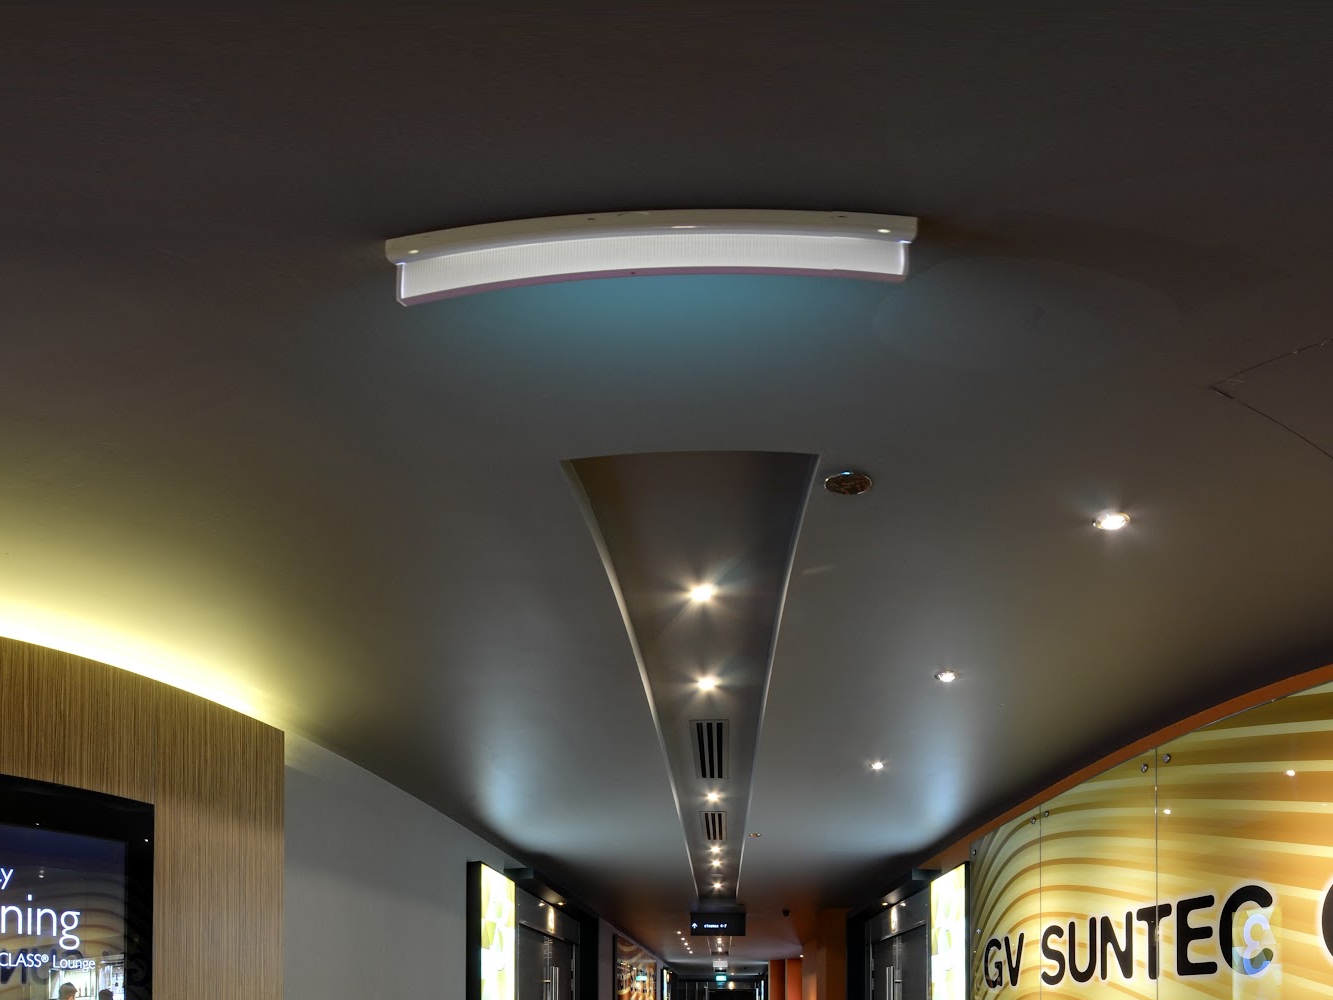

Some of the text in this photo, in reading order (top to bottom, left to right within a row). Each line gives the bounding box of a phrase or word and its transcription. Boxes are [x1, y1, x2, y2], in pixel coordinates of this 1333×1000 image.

[52, 954, 96, 972] Lounge
[984, 885, 1274, 989] GV SUNTEC
